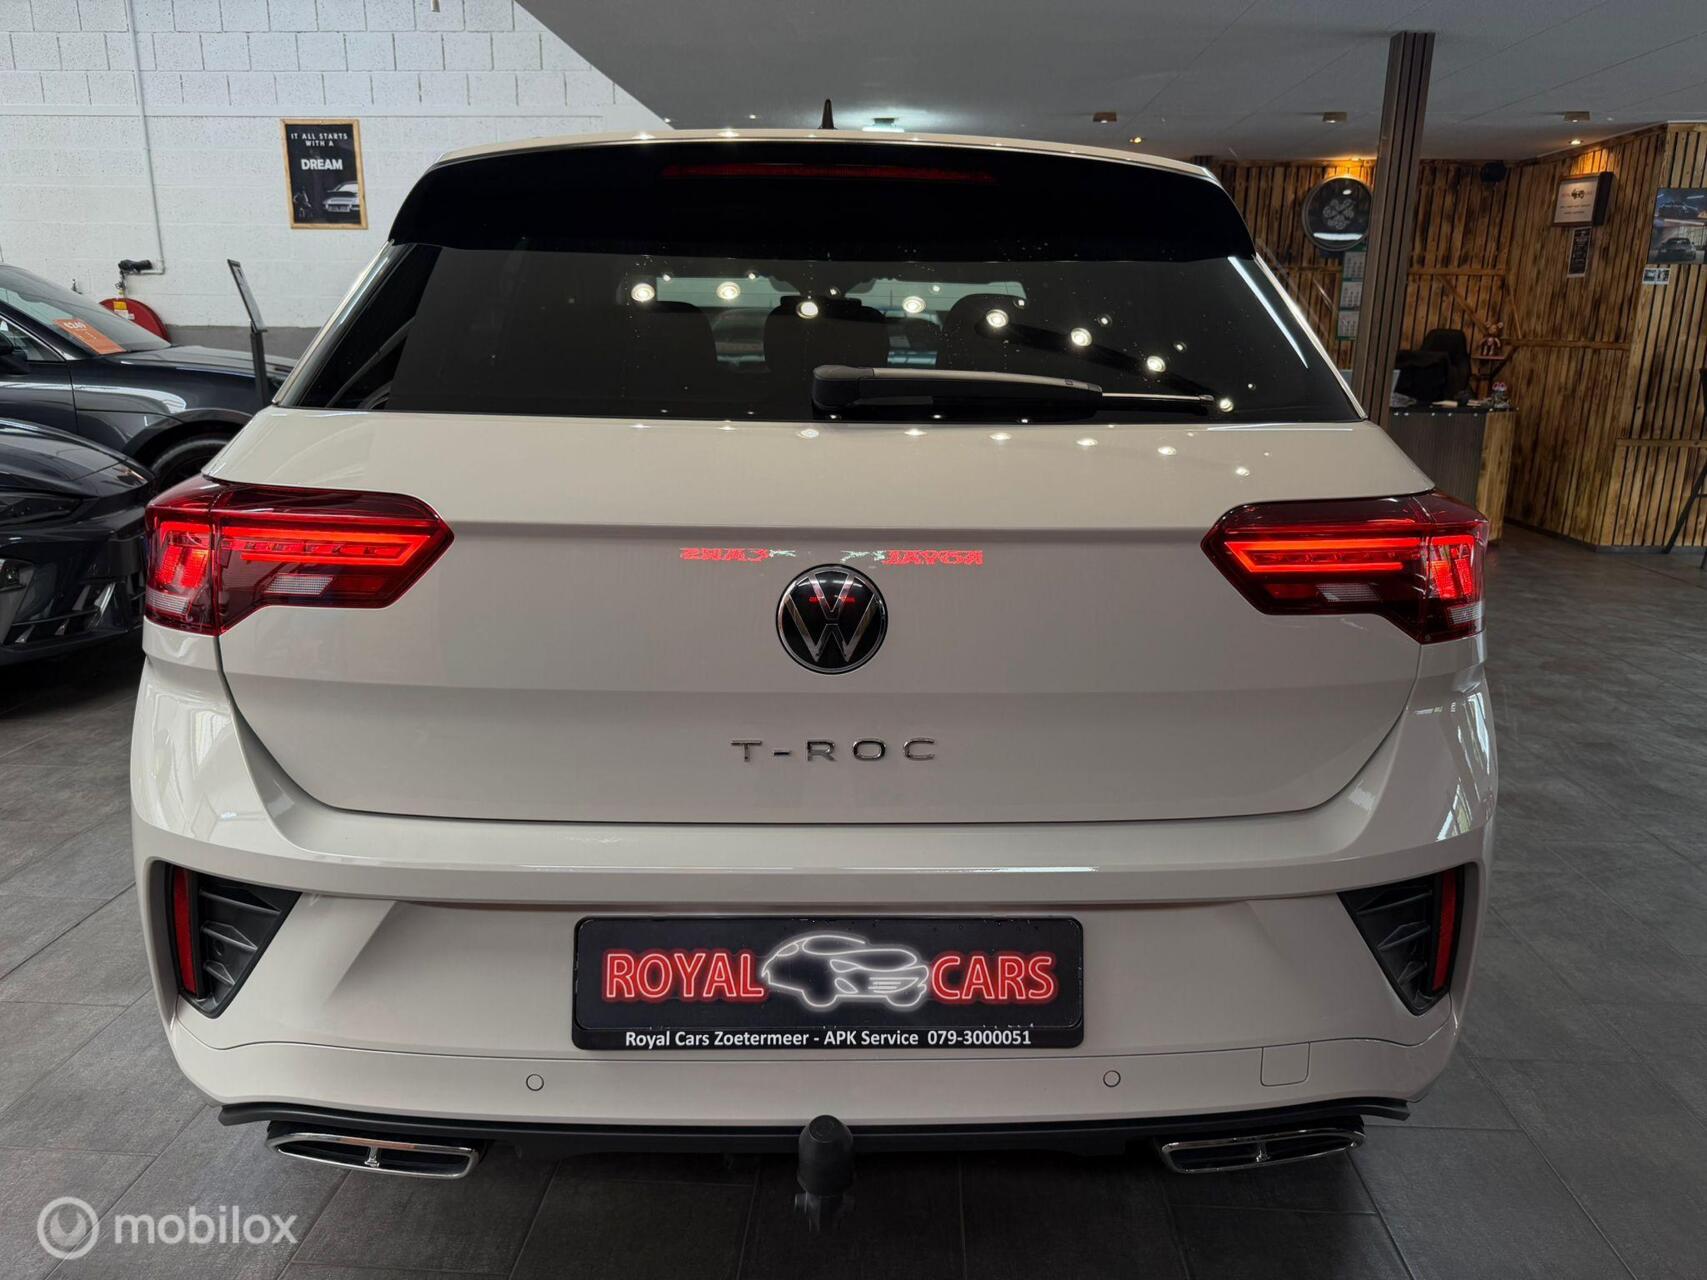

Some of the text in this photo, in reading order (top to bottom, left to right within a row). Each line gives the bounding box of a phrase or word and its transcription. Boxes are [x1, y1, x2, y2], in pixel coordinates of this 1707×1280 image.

[301, 159, 343, 170] DREAM
[782, 571, 879, 663] VW
[730, 737, 936, 763] T-ROC
[605, 952, 1055, 1000] ROYAL CARS
[625, 1031, 671, 1050] Royal
[674, 1031, 710, 1046] Cars
[713, 1031, 810, 1046] Zoetermeer
[823, 1030, 857, 1045] APK
[860, 1030, 919, 1045] Service
[926, 1030, 1032, 1045] 079-3000051
